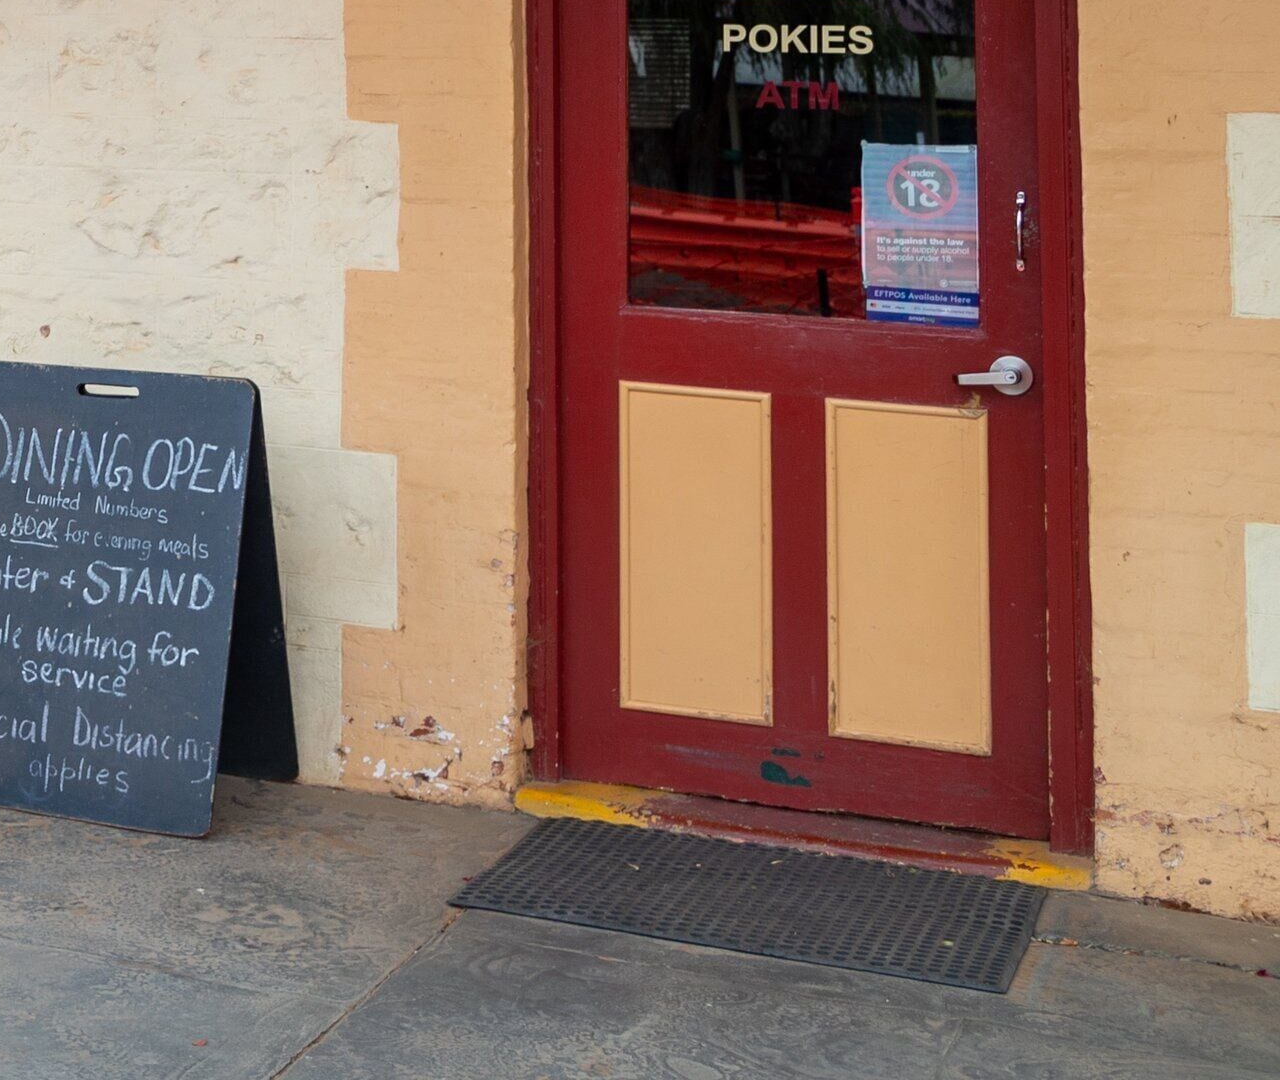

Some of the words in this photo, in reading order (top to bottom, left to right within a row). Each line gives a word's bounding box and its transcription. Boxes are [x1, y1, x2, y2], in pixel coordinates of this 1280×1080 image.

[723, 24, 874, 55] POKIES
[756, 81, 840, 111] ATM
[907, 168, 937, 178] under
[900, 179, 940, 208] 18
[893, 237, 927, 247] against
[929, 237, 945, 246] the
[947, 238, 964, 246] law
[874, 290, 906, 299] EFTPOS
[908, 292, 948, 302] Available
[950, 295, 972, 304] Here
[142, 437, 248, 493] OPEN
[25, 487, 81, 511] Limited
[94, 494, 169, 524] Numbers
[9, 512, 58, 542] BOOK
[64, 519, 90, 545] for
[93, 531, 152, 560] eening
[158, 534, 209, 560] meals
[83, 560, 215, 610] STAND
[147, 631, 200, 667] for
[21, 659, 128, 697] service
[72, 705, 216, 784] Distancing
[29, 753, 130, 793] applies
